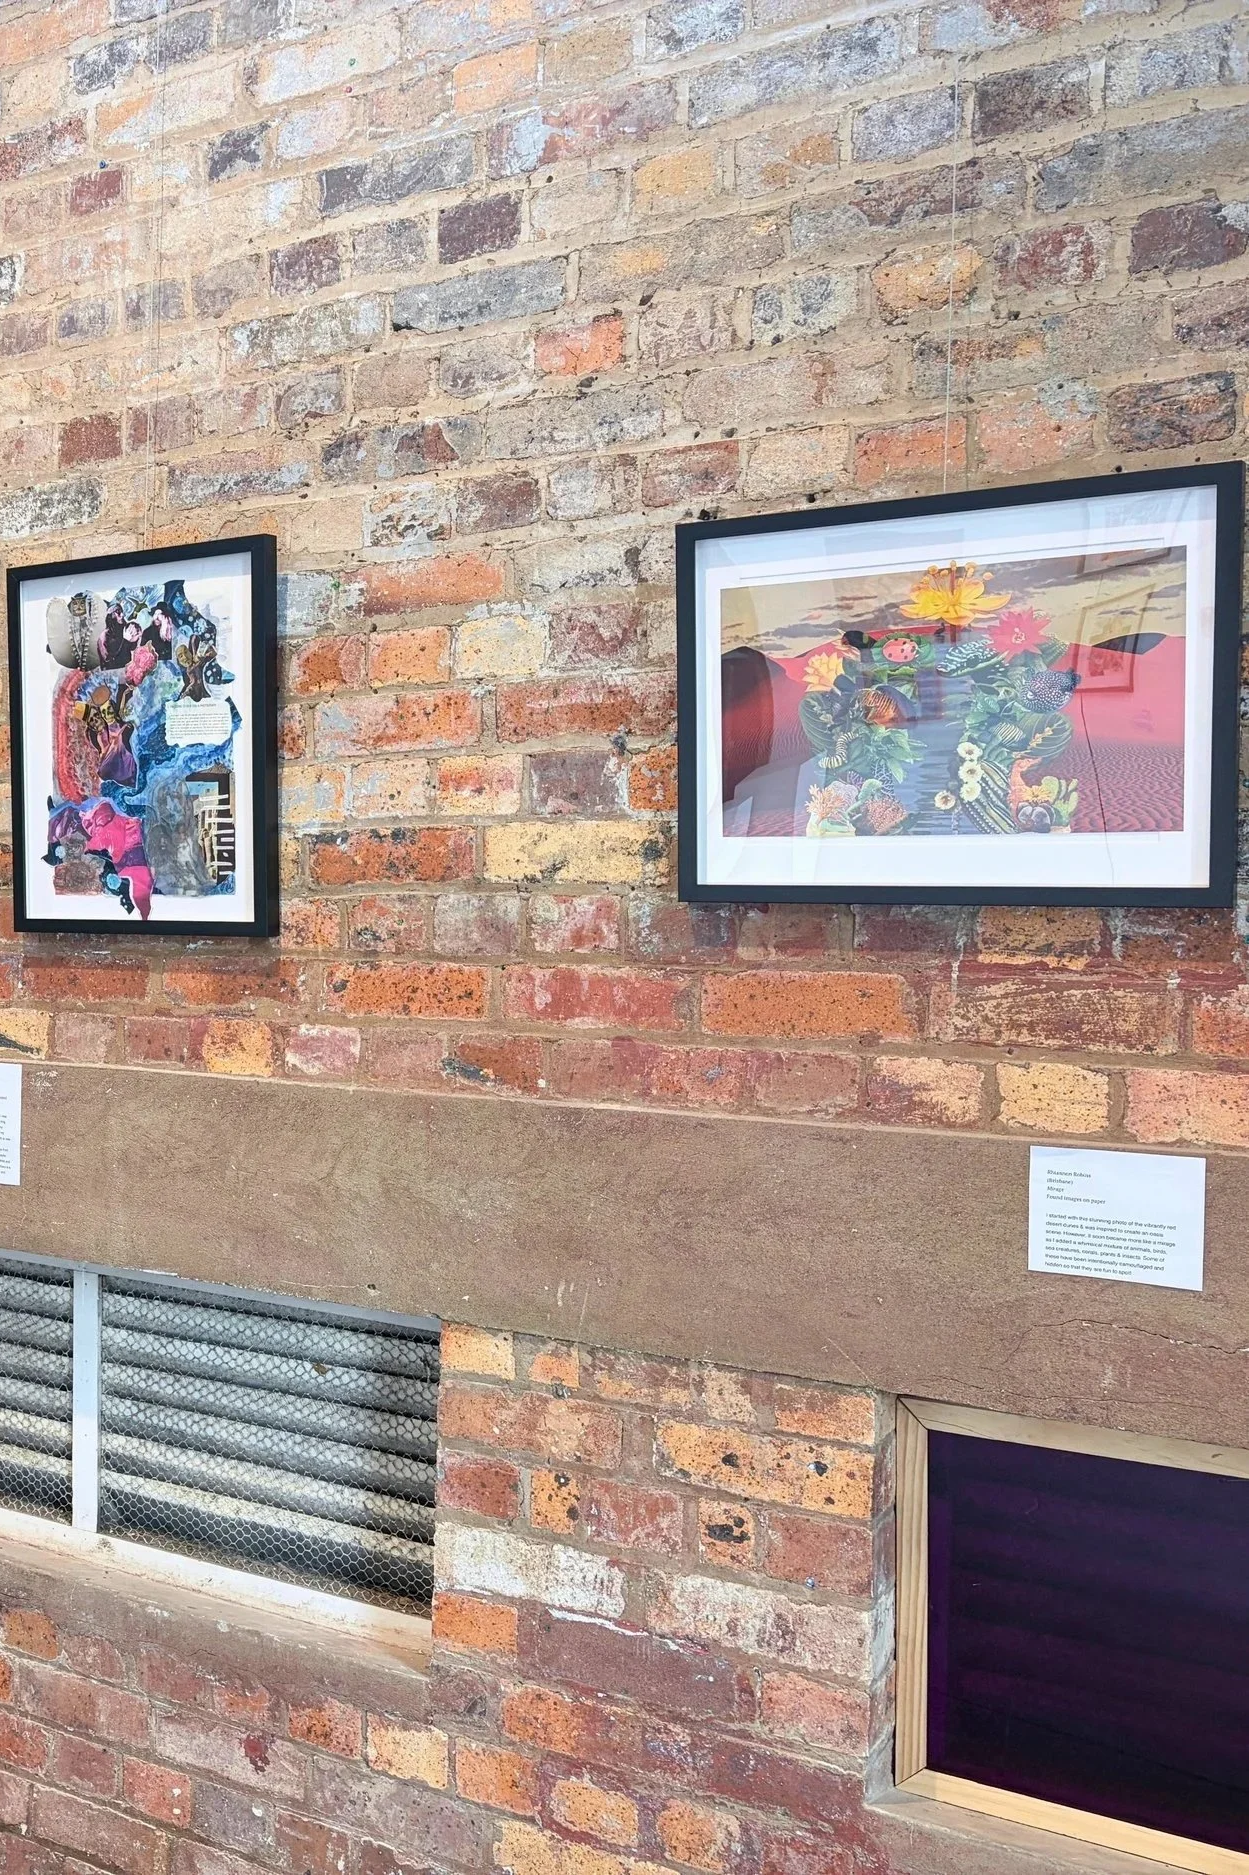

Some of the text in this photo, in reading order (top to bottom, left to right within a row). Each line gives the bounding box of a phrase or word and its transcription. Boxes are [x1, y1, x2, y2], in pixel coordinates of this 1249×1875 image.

[1089, 1218, 1111, 1226] stunning
[1144, 1223, 1166, 1231] vibrantly
[1119, 1262, 1153, 1271] camouflaged
